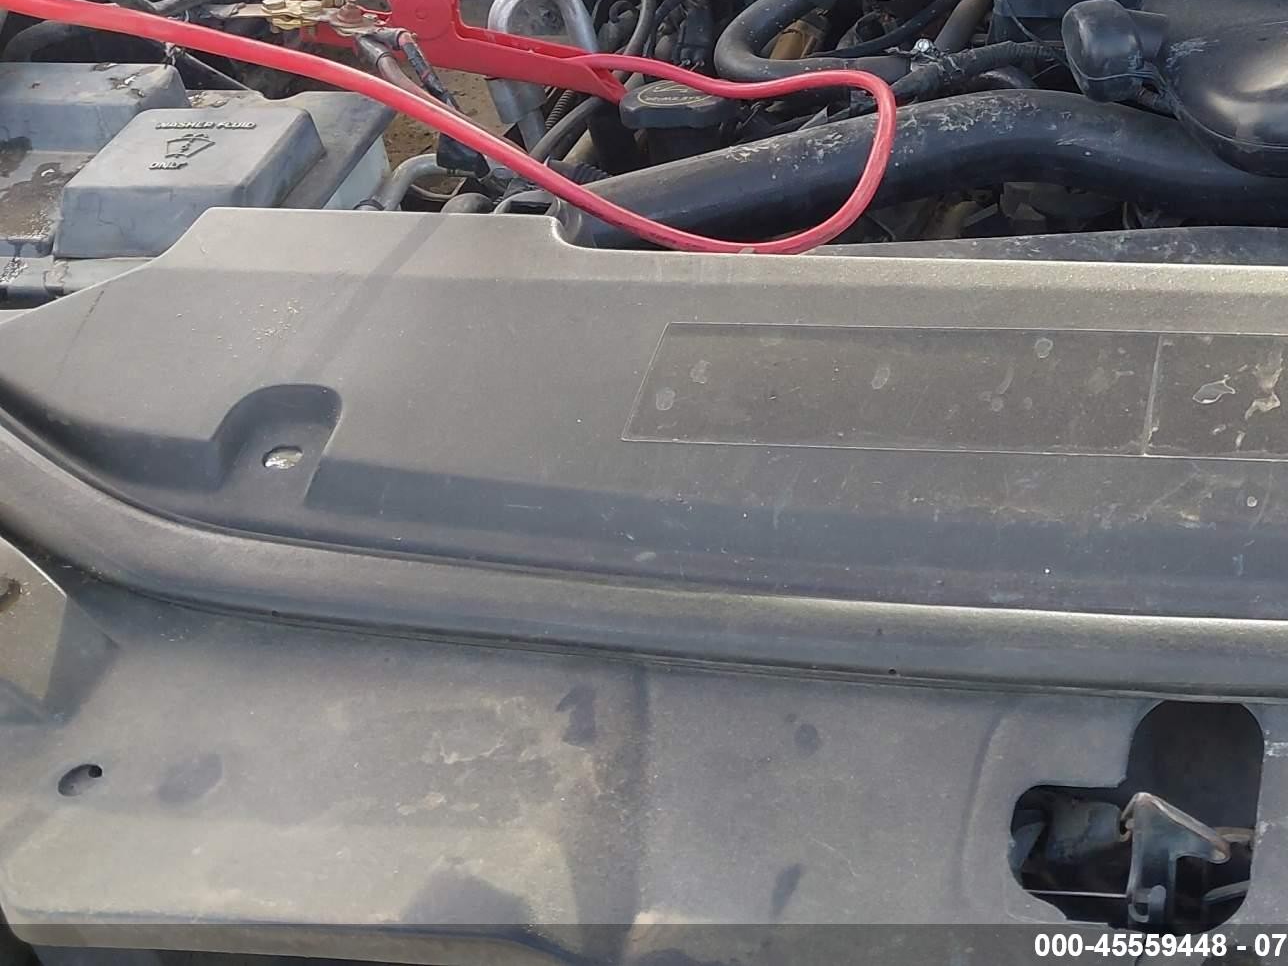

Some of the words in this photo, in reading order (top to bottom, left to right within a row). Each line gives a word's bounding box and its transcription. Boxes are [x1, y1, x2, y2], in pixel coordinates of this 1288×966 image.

[154, 122, 216, 130] WASHER
[216, 122, 258, 130] FLUID
[148, 161, 189, 170] ONLY
